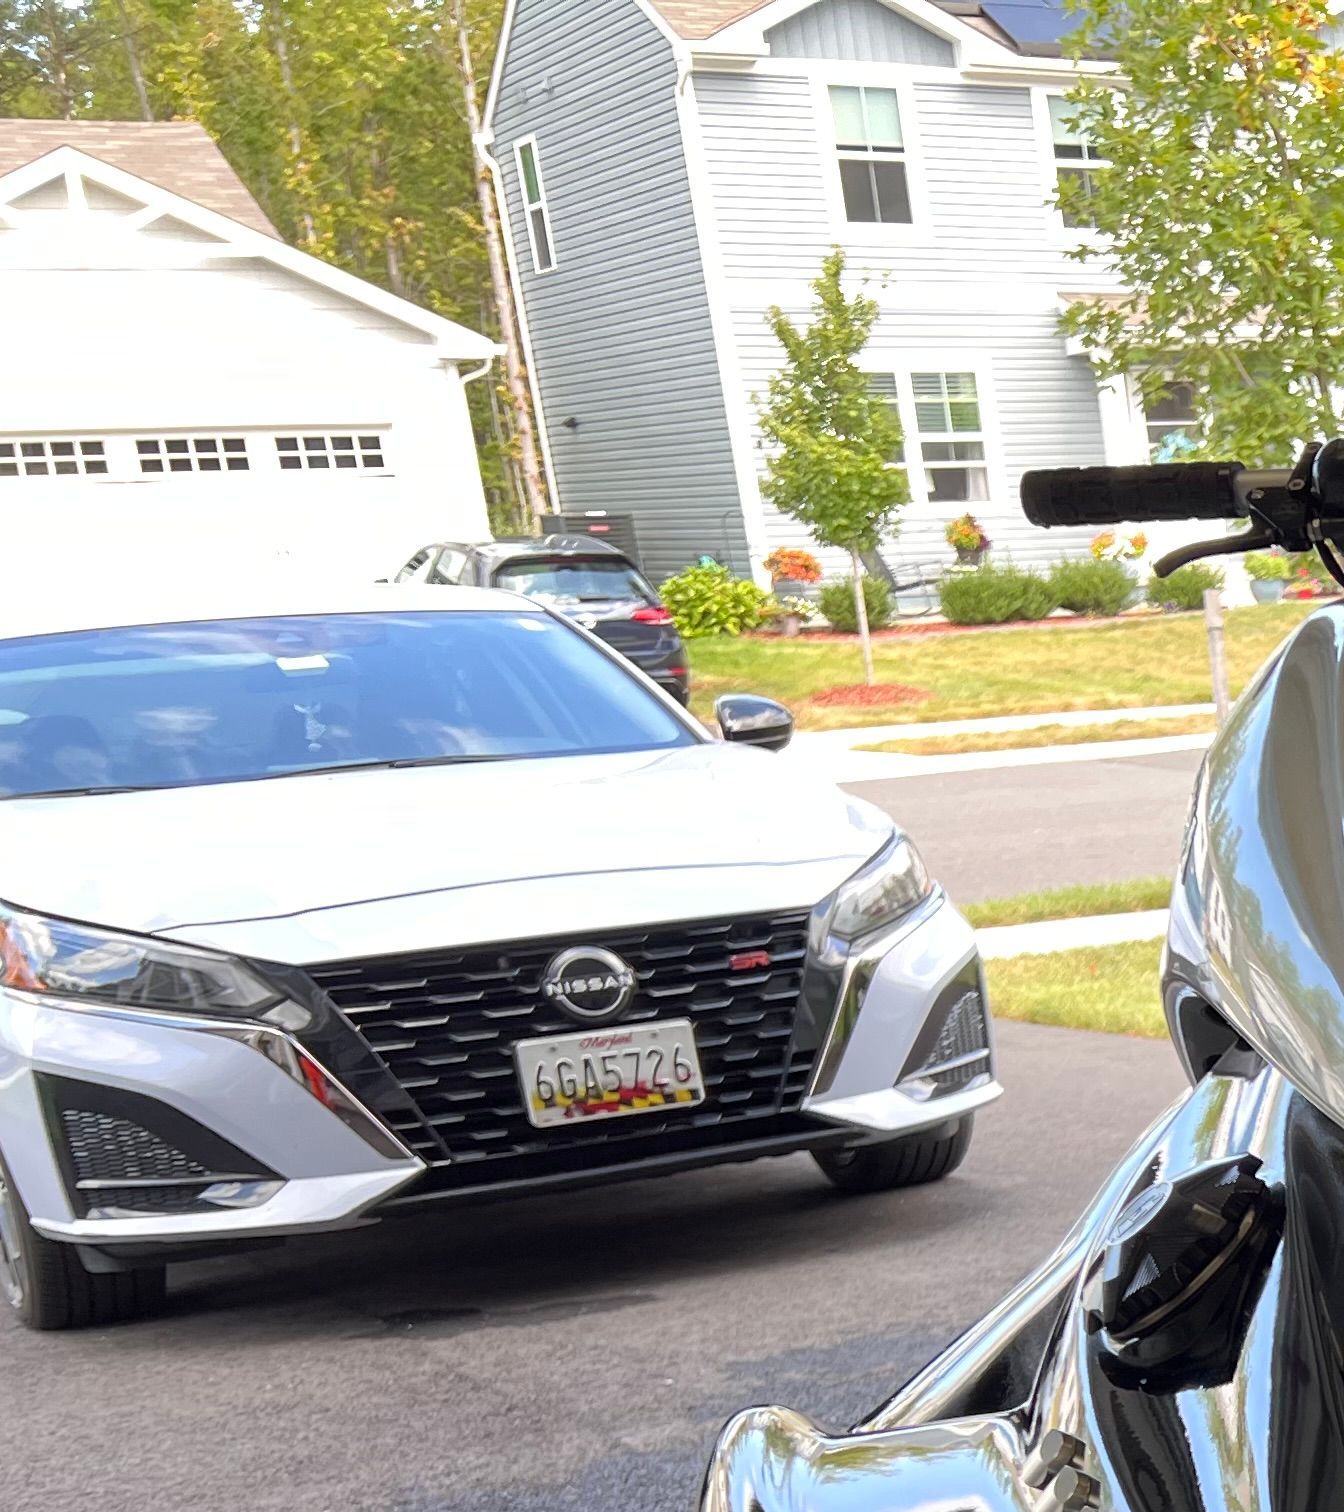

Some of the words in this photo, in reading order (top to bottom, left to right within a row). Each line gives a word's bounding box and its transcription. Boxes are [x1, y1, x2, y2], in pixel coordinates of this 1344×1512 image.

[547, 972, 634, 996] NISSAN
[579, 1033, 633, 1050] Maryland
[535, 1043, 692, 1101] 6GA5726
